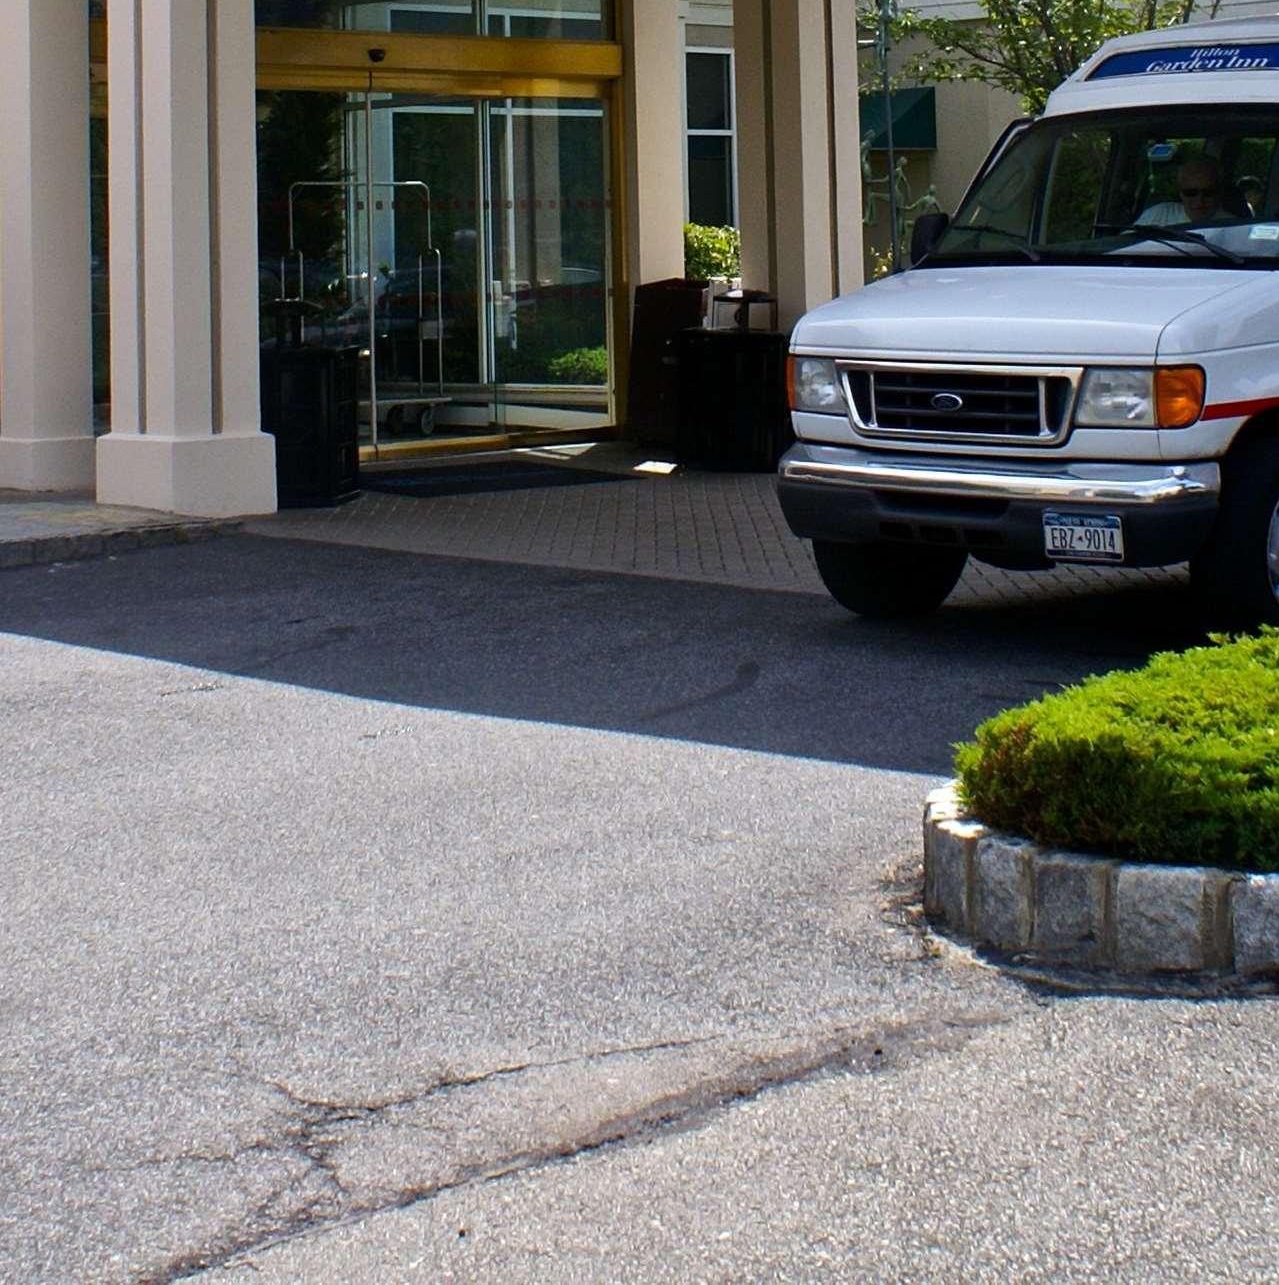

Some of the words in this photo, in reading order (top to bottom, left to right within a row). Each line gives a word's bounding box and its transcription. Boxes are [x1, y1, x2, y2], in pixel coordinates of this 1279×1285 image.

[1190, 48, 1240, 57] Hilton
[1146, 58, 1220, 72] Garden
[1225, 56, 1271, 68] Inn
